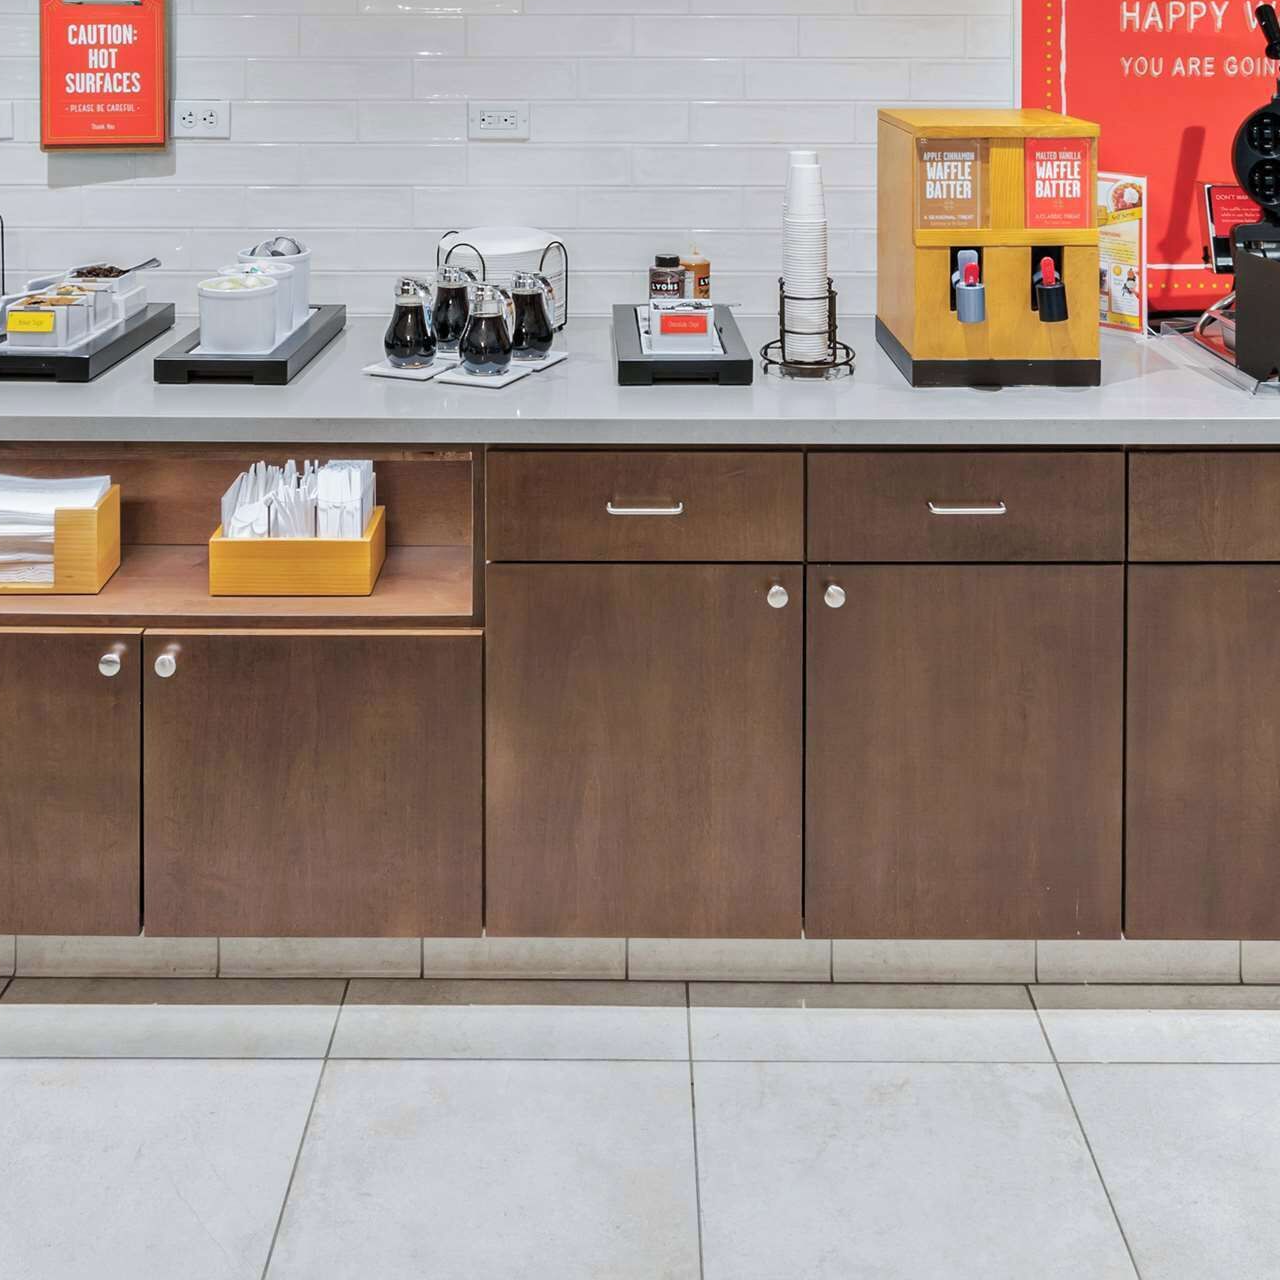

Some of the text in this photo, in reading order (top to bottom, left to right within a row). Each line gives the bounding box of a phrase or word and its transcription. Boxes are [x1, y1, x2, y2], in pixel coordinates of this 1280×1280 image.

[1120, 1, 1230, 33] HAPPY
[67, 23, 138, 45] CAUTION:
[87, 47, 119, 70] HOT
[1121, 56, 1163, 77] YOU
[1172, 56, 1216, 77] ARE
[65, 72, 141, 95] SURFACES
[69, 103, 135, 113] PLEASE BE CAREFUL
[923, 152, 943, 161] APPLE
[1035, 151, 1058, 160] MALTED
[926, 161, 972, 180] WAFFLE
[1036, 161, 1081, 179] WAFFLE
[926, 180, 972, 199] BATTER
[1035, 180, 1081, 198] BATTER
[651, 283, 678, 291] LYONS
